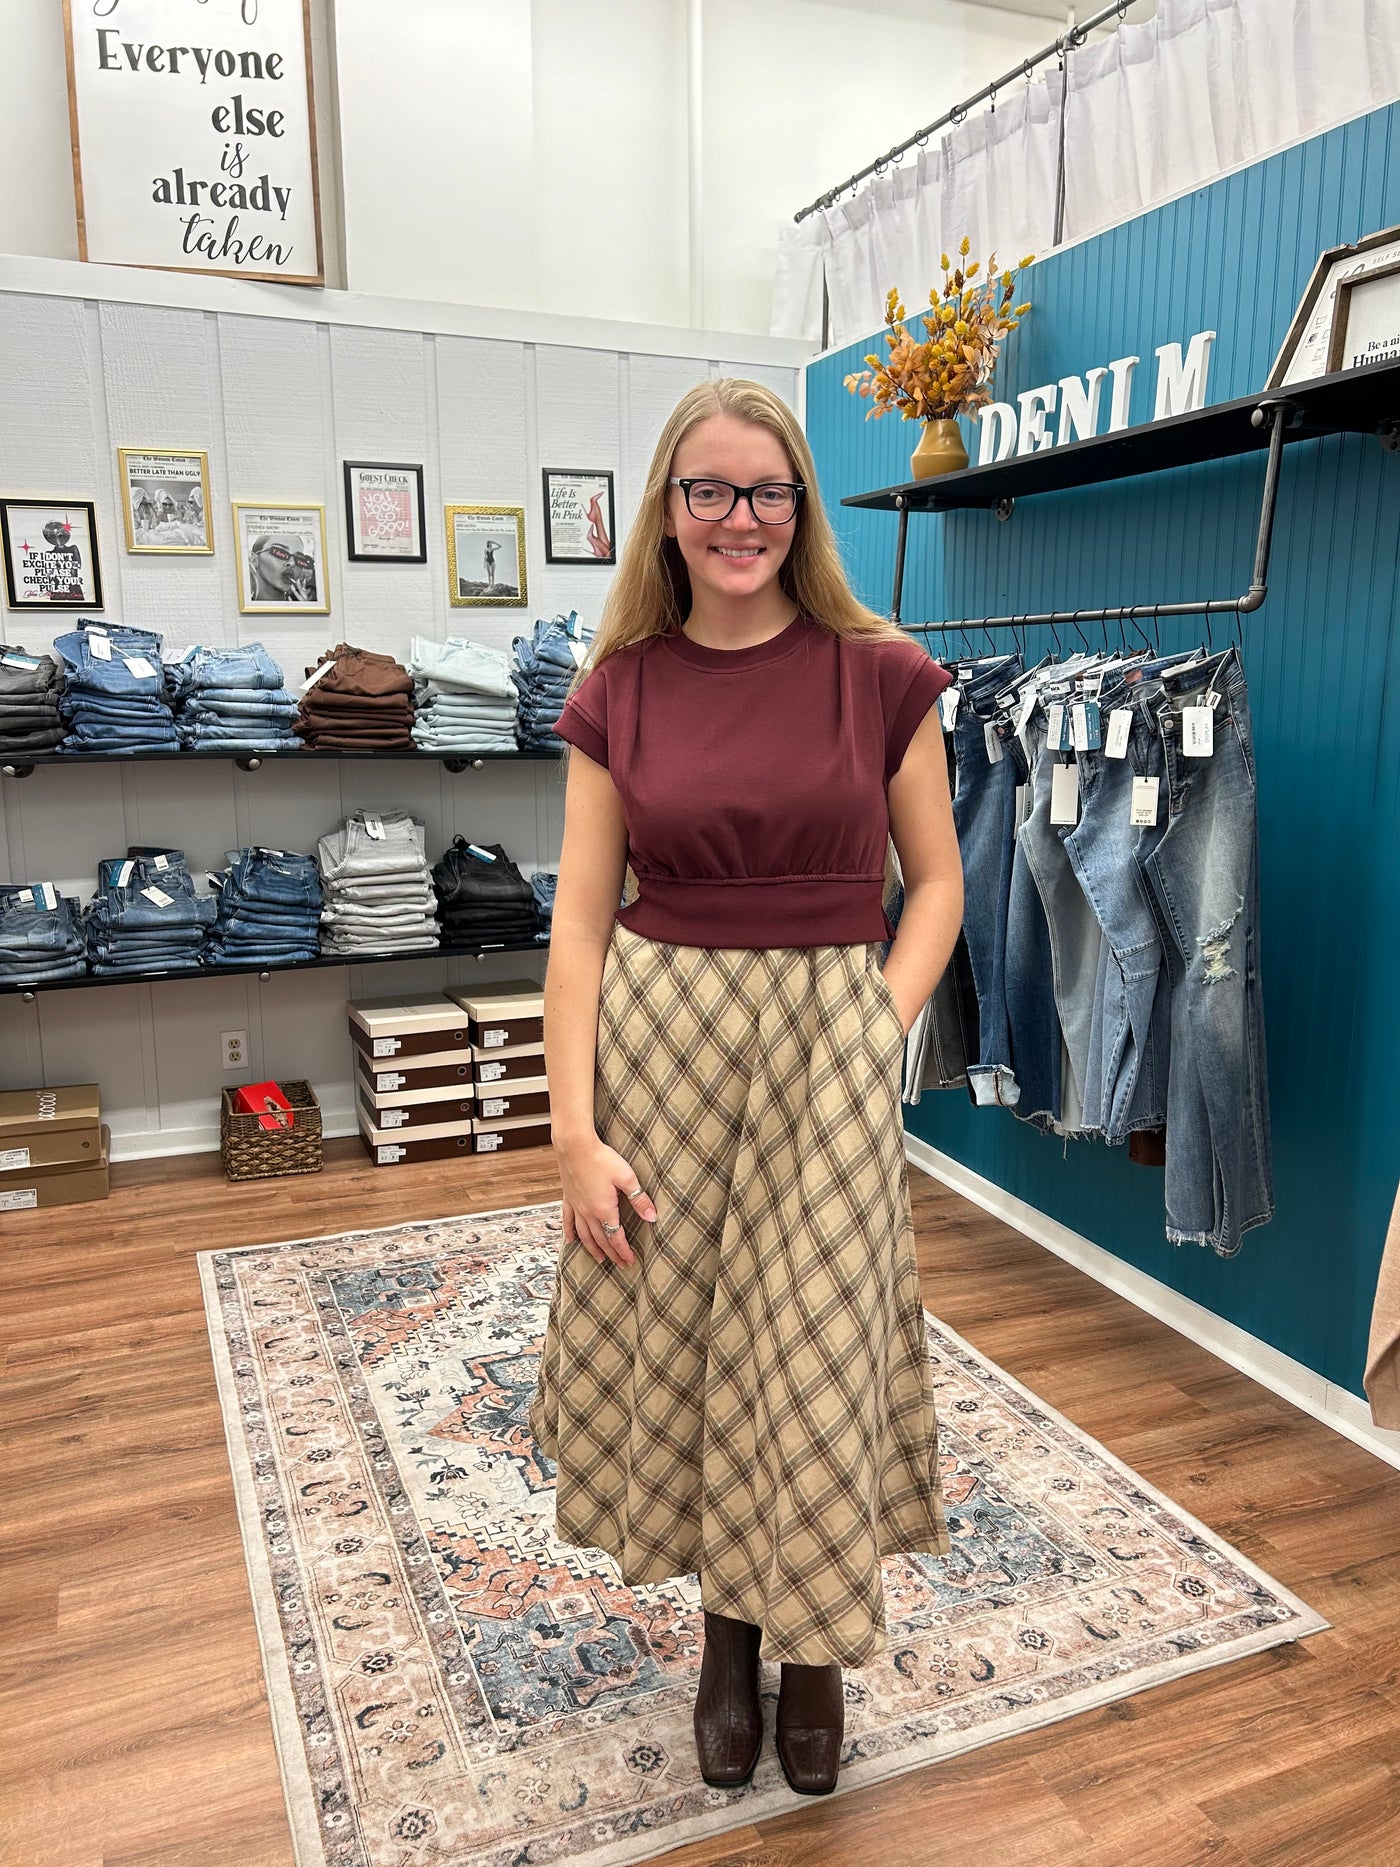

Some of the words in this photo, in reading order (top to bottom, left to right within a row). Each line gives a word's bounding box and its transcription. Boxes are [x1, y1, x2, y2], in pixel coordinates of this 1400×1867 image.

[95, 28, 284, 84] Everyone
[211, 94, 285, 138] else
[220, 142, 250, 179] is
[152, 167, 292, 221] already
[179, 212, 293, 265] taken
[1368, 341, 1381, 351] Be
[1382, 340, 1388, 348] a
[1353, 349, 1400, 368] Huma
[978, 330, 1216, 466] DENIM
[360, 472, 383, 481] GUEST
[384, 473, 408, 483] CHECK
[550, 487, 567, 499] Life
[568, 488, 577, 498] Is
[363, 501, 401, 518] LOOK
[551, 499, 579, 509] Better
[375, 511, 396, 526] SO
[552, 510, 561, 519] In
[562, 509, 583, 520] Pink
[29, 552, 39, 560] IF
[45, 552, 74, 561] DON'T
[22, 560, 57, 569] EXCITE
[35, 568, 72, 577] PLEASE
[23, 576, 56, 585] CHECK
[57, 576, 84, 586] YOUR
[39, 584, 71, 593] PULSE
